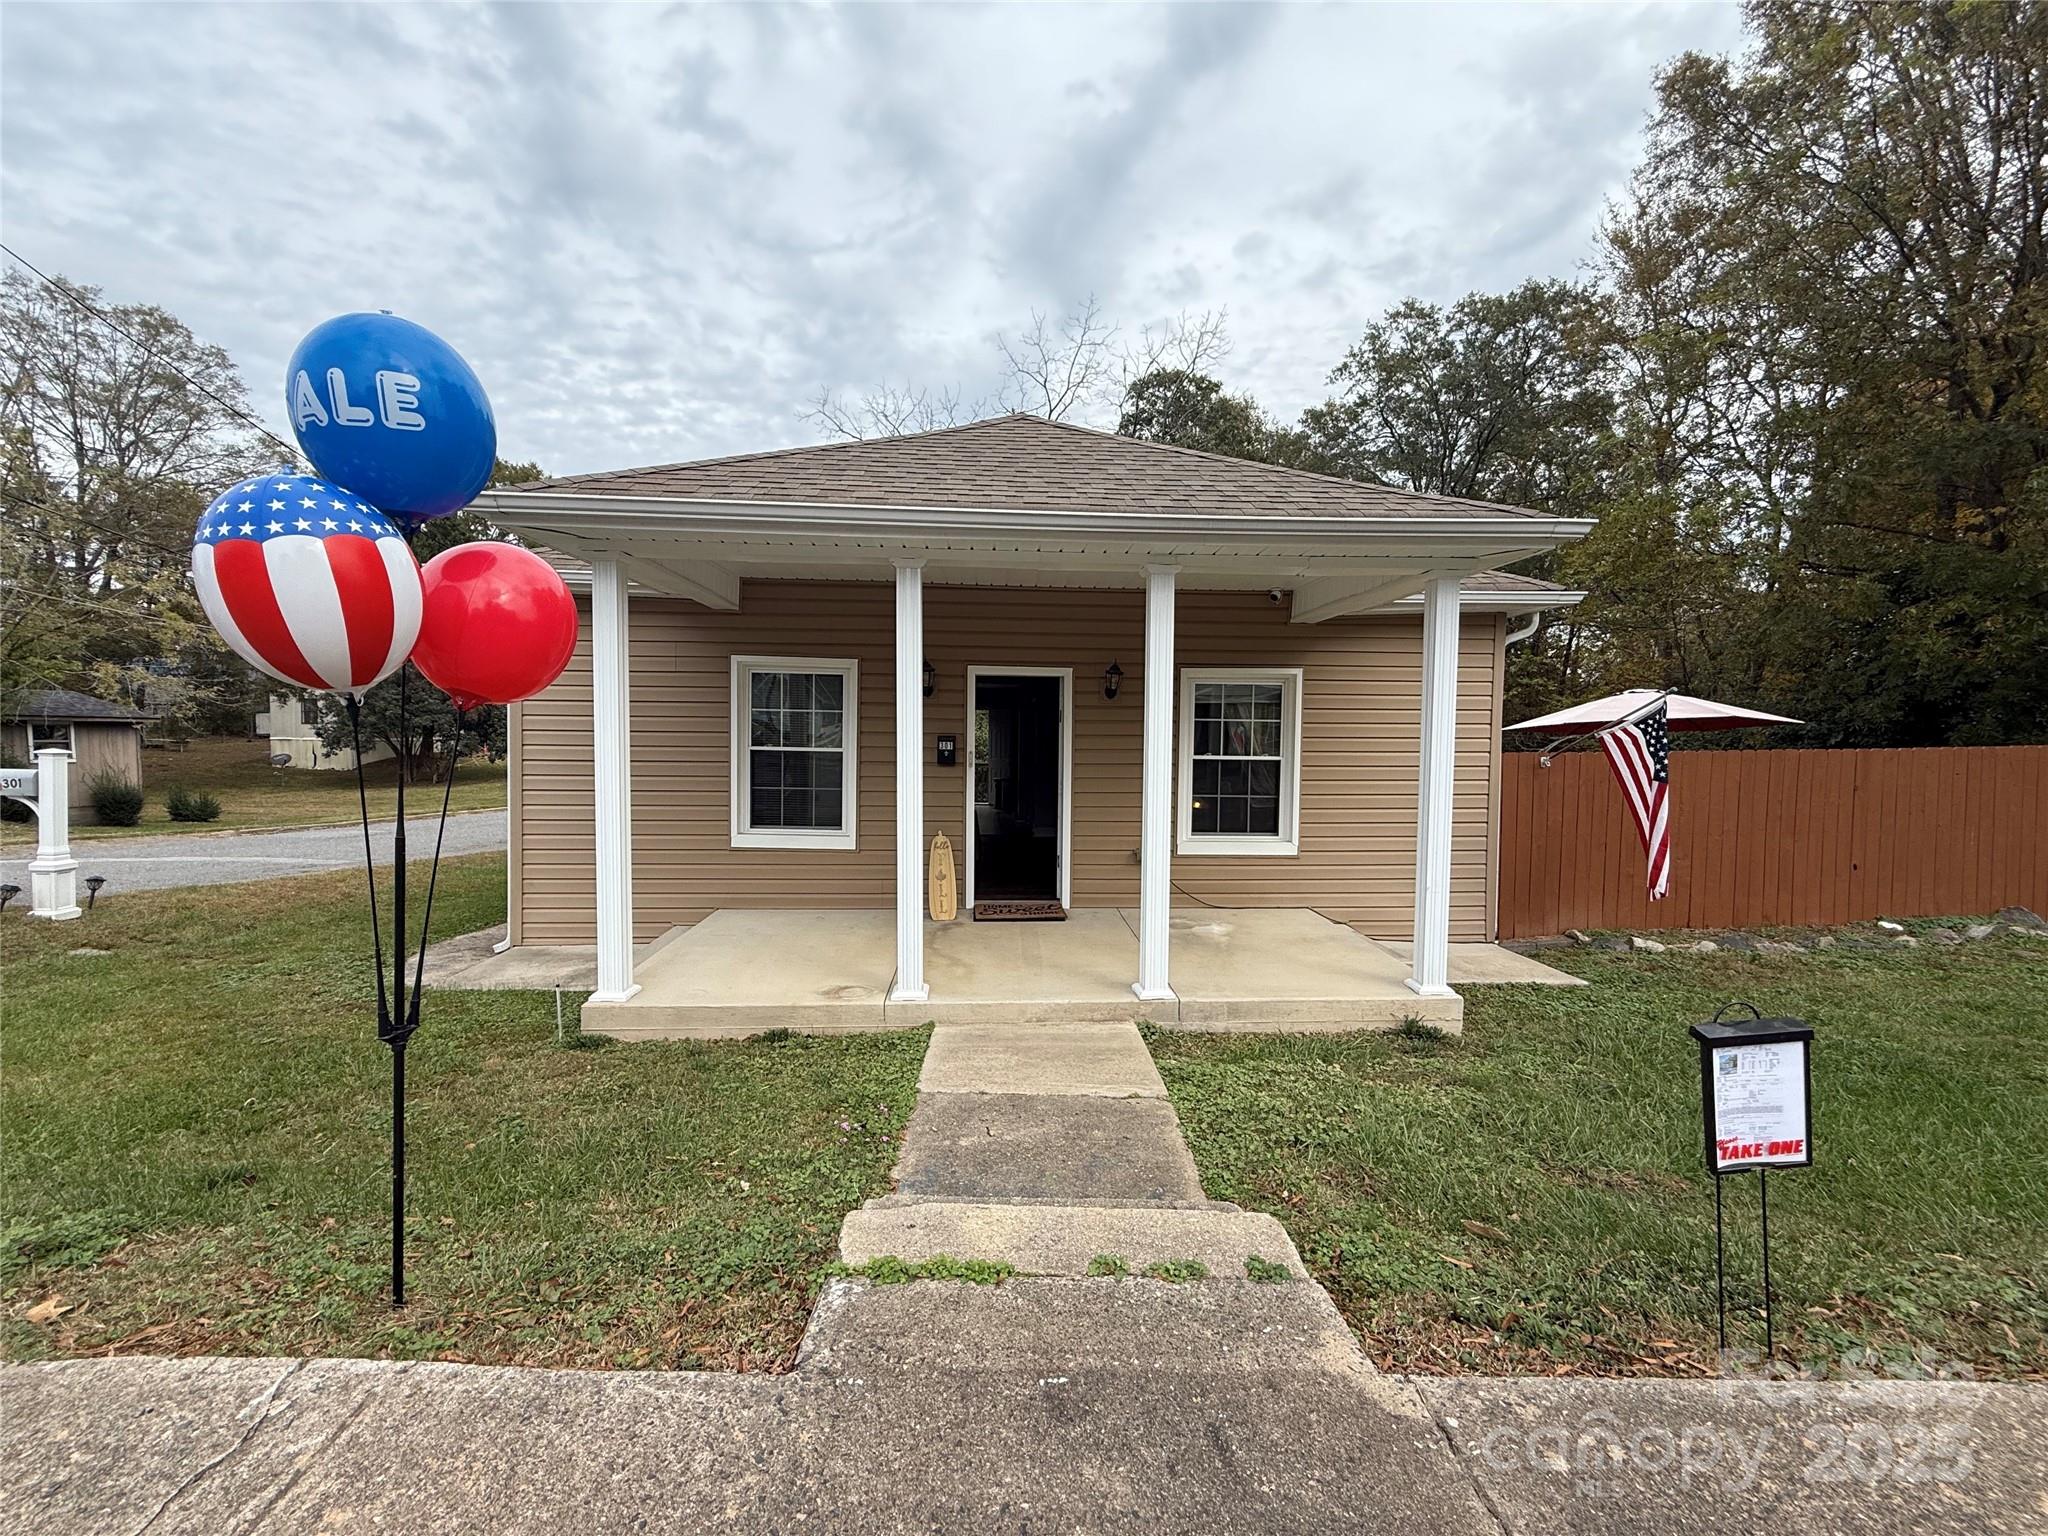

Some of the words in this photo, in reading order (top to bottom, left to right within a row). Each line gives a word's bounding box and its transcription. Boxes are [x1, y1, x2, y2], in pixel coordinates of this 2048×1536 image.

[2, 778, 22, 788] 301
[1720, 1143, 1763, 1160] TAKE
[1768, 1139, 1804, 1155] ONE
